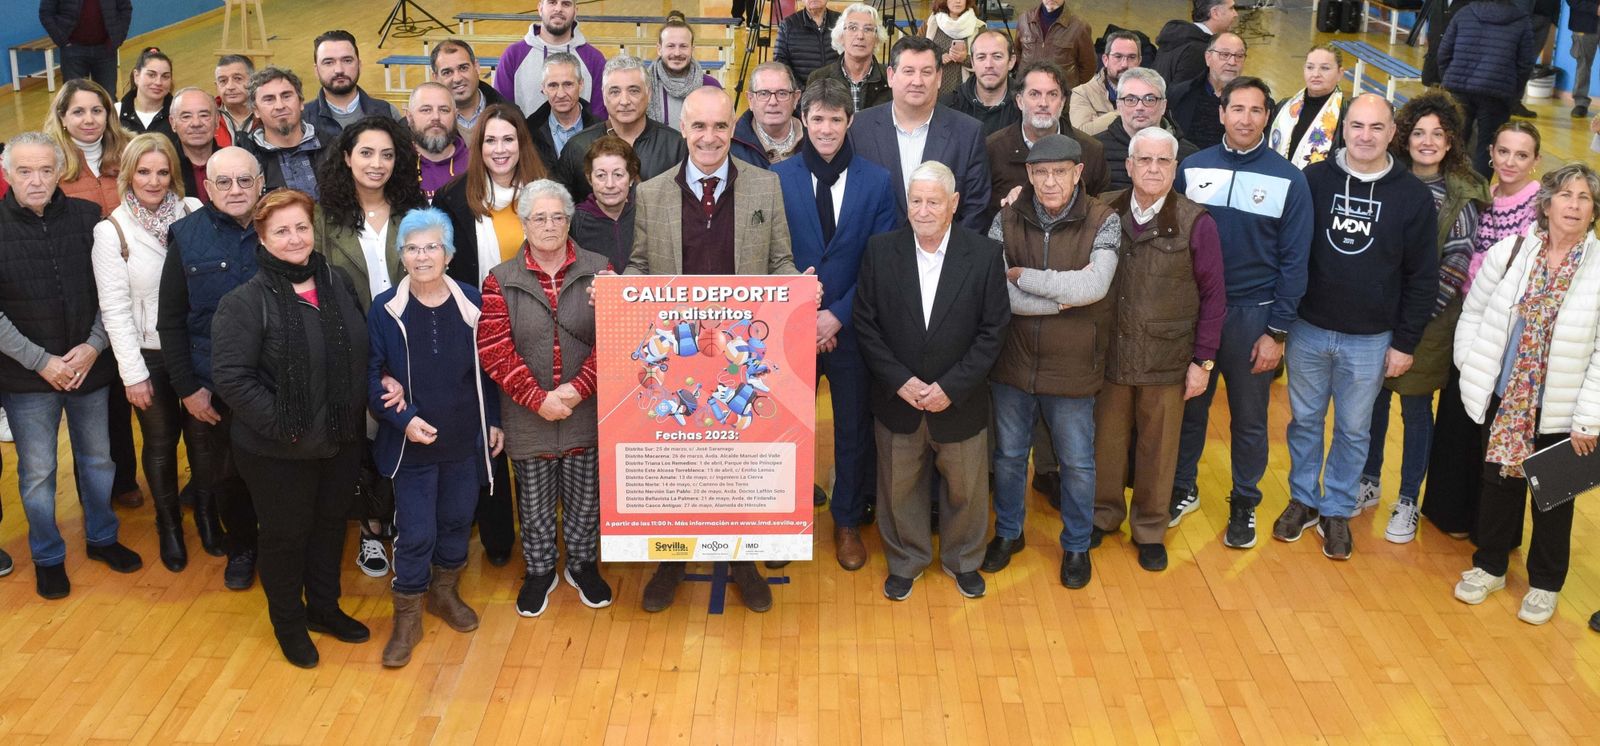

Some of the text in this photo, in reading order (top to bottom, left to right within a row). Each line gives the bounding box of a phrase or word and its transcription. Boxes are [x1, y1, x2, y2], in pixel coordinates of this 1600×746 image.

[1332, 216, 1371, 236] MDN
[622, 286, 789, 302] CALLE DEPORTE
[658, 307, 753, 320] en distritos
[656, 431, 740, 440] Fechas 2023:
